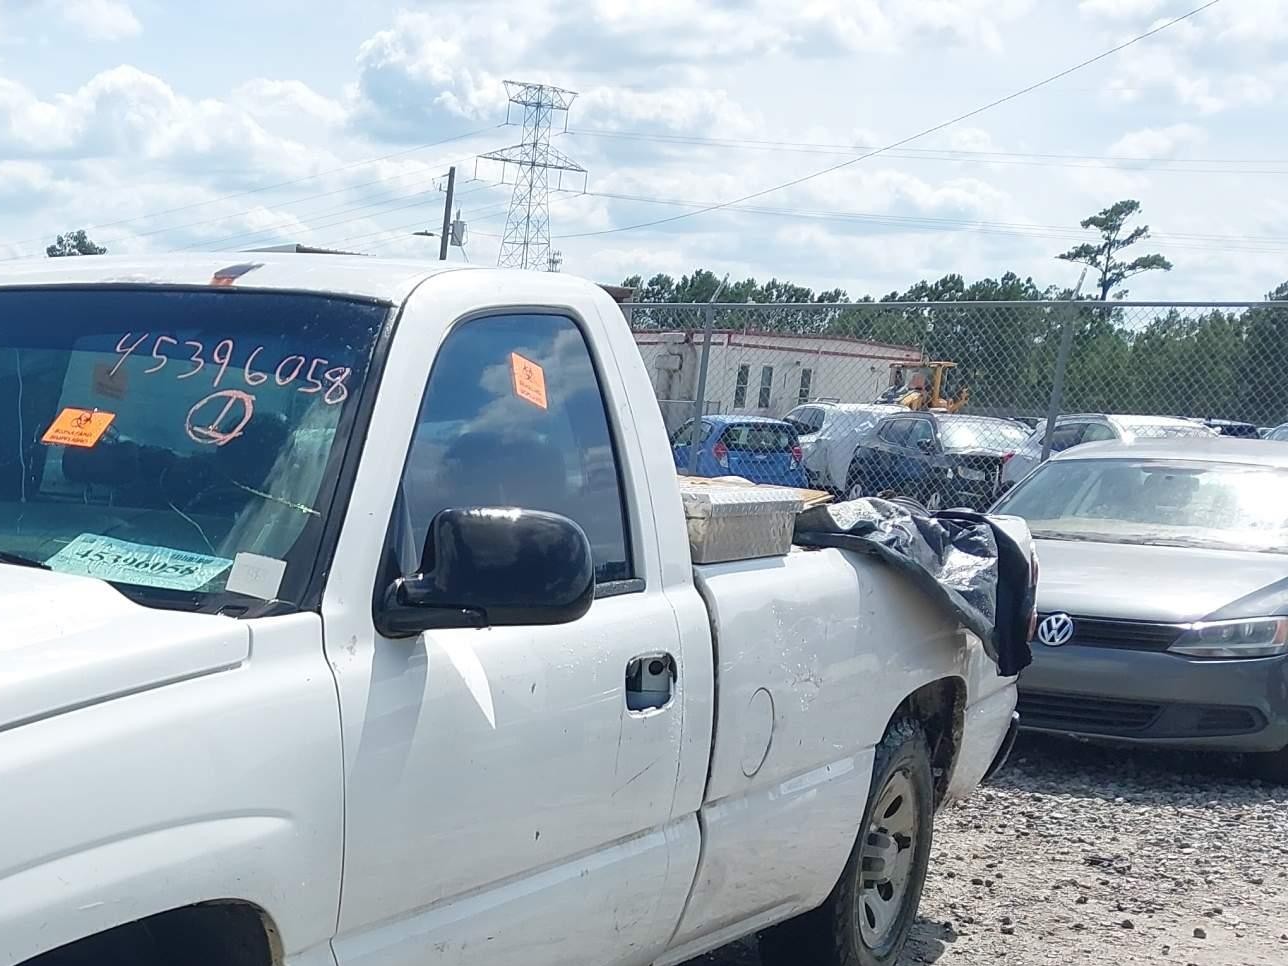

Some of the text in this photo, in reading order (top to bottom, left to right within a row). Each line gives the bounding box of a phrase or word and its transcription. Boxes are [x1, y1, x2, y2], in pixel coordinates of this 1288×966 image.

[109, 332, 352, 405] 45396058
[75, 548, 200, 578] 45396058
[1038, 613, 1073, 646] VW
